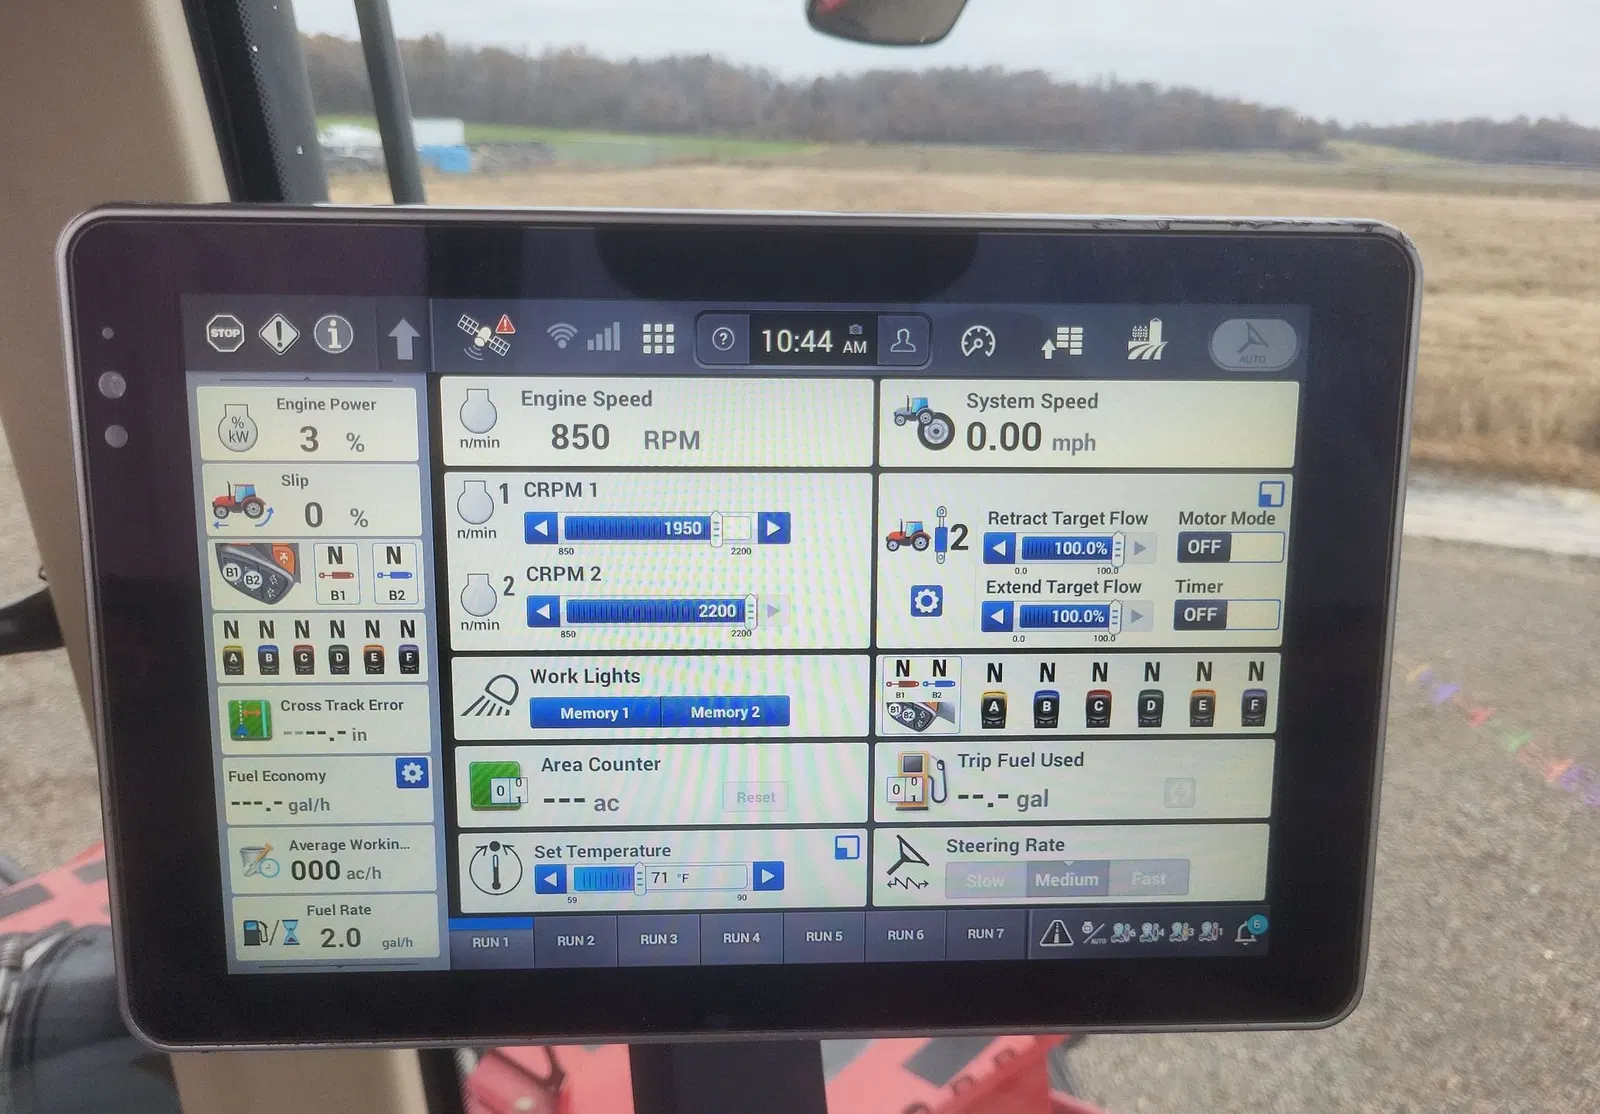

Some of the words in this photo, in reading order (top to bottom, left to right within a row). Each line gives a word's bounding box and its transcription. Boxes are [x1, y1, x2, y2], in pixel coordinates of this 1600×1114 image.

[210, 329, 240, 338] STOP
[761, 329, 833, 353] 10:44
[842, 340, 867, 354] AM
[1238, 354, 1267, 364] AUTO
[276, 397, 326, 414] Engine
[330, 398, 377, 411] Power
[520, 390, 587, 411] Engine
[592, 390, 653, 411] Speed
[966, 392, 1035, 413] System
[1040, 392, 1099, 413] Speed
[228, 430, 250, 443] kW
[299, 426, 319, 452] 3
[345, 432, 365, 453] %
[459, 436, 500, 449] n/min
[551, 423, 610, 450] 850
[644, 430, 700, 450] RPM
[966, 421, 1042, 452] 0.00
[1051, 433, 1097, 456] mph
[281, 473, 310, 490] Slip
[499, 483, 509, 504] 1
[524, 482, 583, 498] CRPM
[589, 482, 597, 498] 1
[304, 501, 324, 528] 0
[350, 508, 369, 528] %
[988, 511, 1048, 526] Retract
[1052, 511, 1105, 529] Target
[1109, 510, 1148, 526] Flow
[1178, 511, 1227, 526] Motor
[1231, 510, 1276, 526] Mode
[457, 527, 497, 539] n/min
[664, 521, 702, 535] 1950
[950, 523, 969, 551] 2
[558, 547, 575, 556] 850
[731, 547, 752, 556] 2200
[1054, 540, 1108, 555] 100.0%
[1187, 539, 1222, 555] OFF
[327, 546, 344, 565] N
[386, 546, 402, 565] N
[225, 567, 239, 578] B1
[526, 566, 584, 582] CRPM
[590, 566, 602, 582] 2
[1014, 567, 1028, 575] 0.0
[1096, 566, 1119, 575] 100.0
[245, 574, 261, 586] B2
[503, 575, 515, 597] 2
[1175, 578, 1224, 594] Timer
[330, 590, 346, 601] B1
[389, 590, 406, 601] B2
[986, 579, 1042, 594] Extend
[1046, 580, 1100, 597] Target
[1103, 579, 1143, 594] Flow
[698, 603, 737, 618] 2200
[1052, 608, 1105, 623] 100.0%
[1183, 607, 1218, 622] OFF
[223, 619, 240, 639] N
[259, 619, 276, 639] N
[294, 619, 311, 639] N
[329, 619, 346, 639] N
[364, 619, 381, 639] N
[400, 619, 417, 639] N
[460, 619, 500, 631] n/min
[560, 630, 576, 639] 850
[731, 629, 752, 638] 2200
[1012, 635, 1026, 643] 0.0
[1093, 634, 1116, 642] 100.0
[229, 653, 238, 662] A
[264, 652, 273, 662] B
[300, 652, 309, 662] C
[335, 652, 344, 662] D
[370, 652, 378, 662] E
[405, 652, 413, 662] F
[895, 659, 910, 678] N
[932, 659, 947, 677] N
[986, 662, 1003, 683] N
[1039, 662, 1056, 683] N
[1092, 661, 1108, 683] N
[1144, 661, 1161, 682] N
[1196, 661, 1213, 682] N
[1248, 661, 1265, 682] N
[530, 668, 579, 685] Work
[584, 667, 641, 687] Lights
[932, 691, 942, 699] B2
[280, 699, 322, 712] Cross
[325, 699, 365, 712] Track
[369, 699, 404, 711] Error
[988, 701, 1000, 713] A
[1042, 701, 1052, 712] B
[1094, 700, 1104, 712] C
[1146, 700, 1156, 711] D
[1198, 700, 1207, 711] E
[1251, 699, 1259, 710] F
[560, 707, 619, 722] Memory
[622, 707, 629, 719] 1
[691, 706, 749, 721] Memory
[751, 706, 761, 718] 2
[352, 728, 368, 742] in
[541, 757, 583, 773] Area
[588, 756, 661, 772] Counter
[958, 752, 992, 772] Trip
[998, 752, 1036, 768] Fuel
[1041, 751, 1084, 768] Used
[228, 770, 259, 783] Fuel
[262, 771, 327, 784] Economy
[737, 791, 776, 803] Reset
[1016, 788, 1049, 813] gal
[288, 798, 331, 816] gal/h
[593, 798, 620, 812] ac
[289, 840, 346, 854] Average
[350, 838, 411, 851] Workin...
[534, 845, 563, 859] Set
[566, 844, 674, 861] Temperature
[946, 837, 1019, 856] Steering
[1025, 837, 1065, 852] Rate
[291, 859, 341, 881] 000
[346, 866, 382, 881] ac/h
[651, 871, 668, 884] 71
[677, 873, 690, 884] °F
[966, 873, 1005, 888] Slow
[1035, 872, 1099, 888] Medium
[1131, 871, 1166, 886] Fast
[737, 893, 748, 902] 90
[306, 904, 336, 916] Fuel
[340, 904, 372, 916] Rate
[1253, 919, 1260, 929] 6
[320, 927, 361, 948] 2.0
[382, 936, 413, 950] gal/h
[557, 935, 584, 947] RUN
[585, 935, 595, 946] 2
[640, 933, 668, 945] RUN
[669, 933, 679, 945] 3
[723, 932, 750, 944] RUN
[751, 932, 761, 943] 4
[806, 931, 833, 942] RUN
[835, 931, 843, 941] 5
[887, 930, 914, 940] RUN
[916, 929, 925, 940] 6
[967, 928, 994, 939] RUN
[995, 928, 1005, 939] 7
[1090, 937, 1107, 945] AUTO
[1130, 929, 1136, 938] 6
[472, 937, 502, 948] RUN
[502, 936, 509, 947] 1
